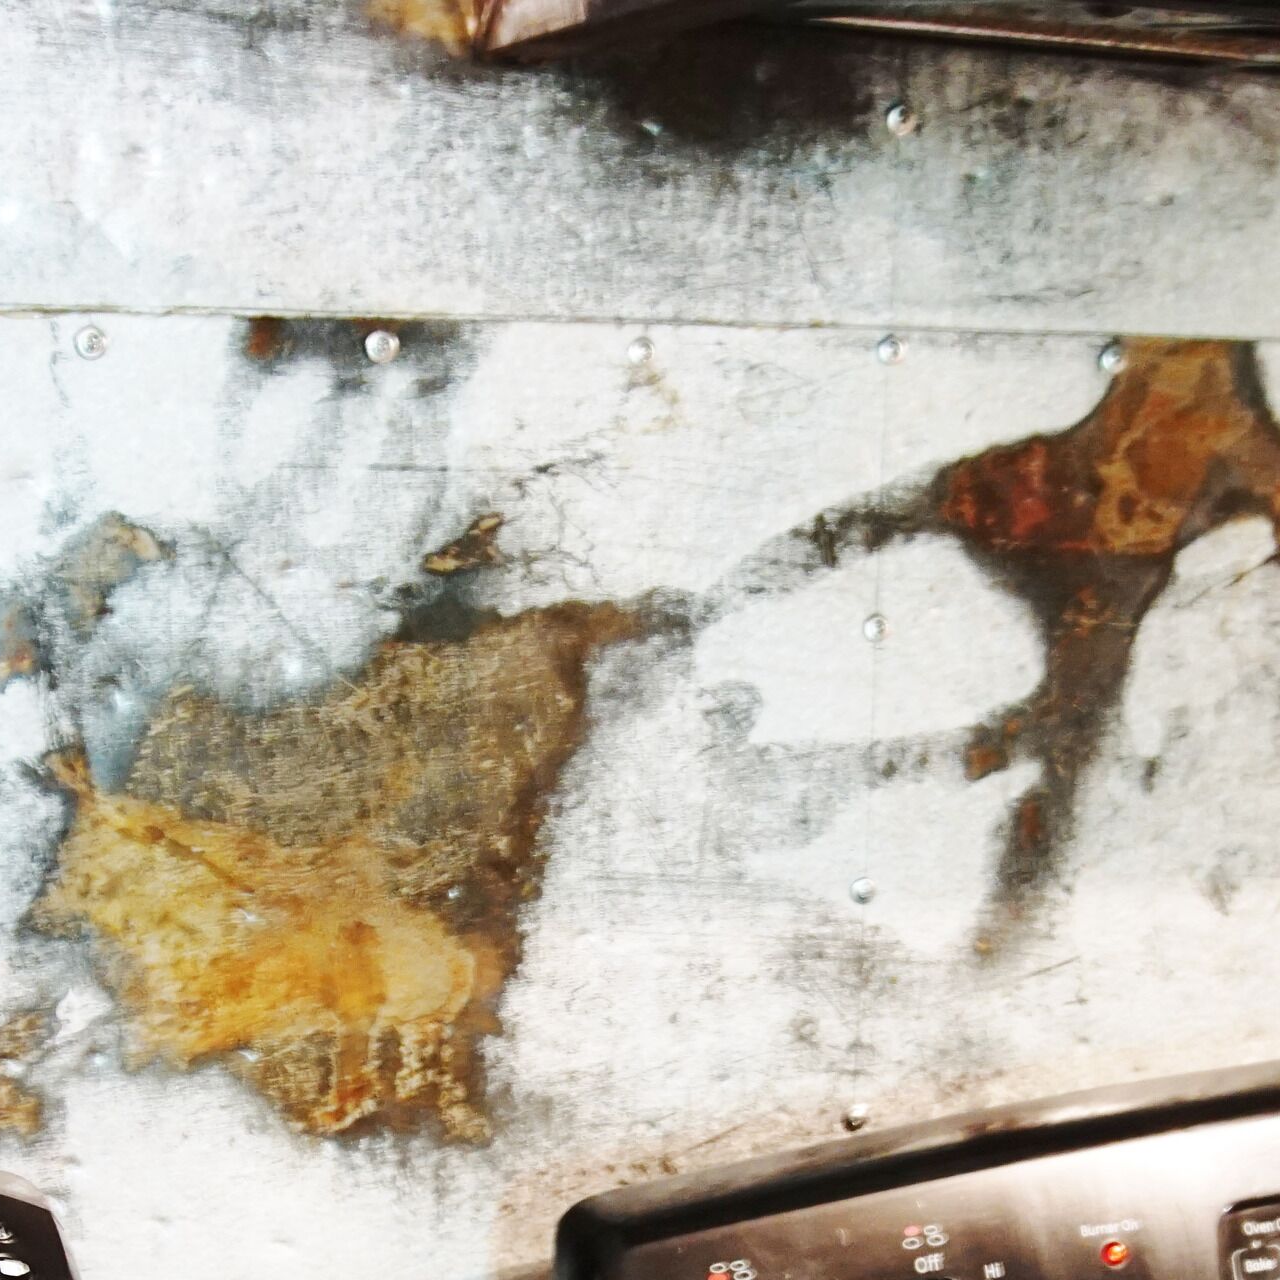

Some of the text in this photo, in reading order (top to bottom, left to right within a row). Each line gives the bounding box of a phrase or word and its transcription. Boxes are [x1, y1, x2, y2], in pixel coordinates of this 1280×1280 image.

[1080, 1219, 1140, 1237] Burner On
[1243, 1221, 1275, 1236] Oven
[914, 1253, 944, 1274] Off
[983, 1262, 1005, 1279] Hi
[1244, 1258, 1277, 1273] Bake
